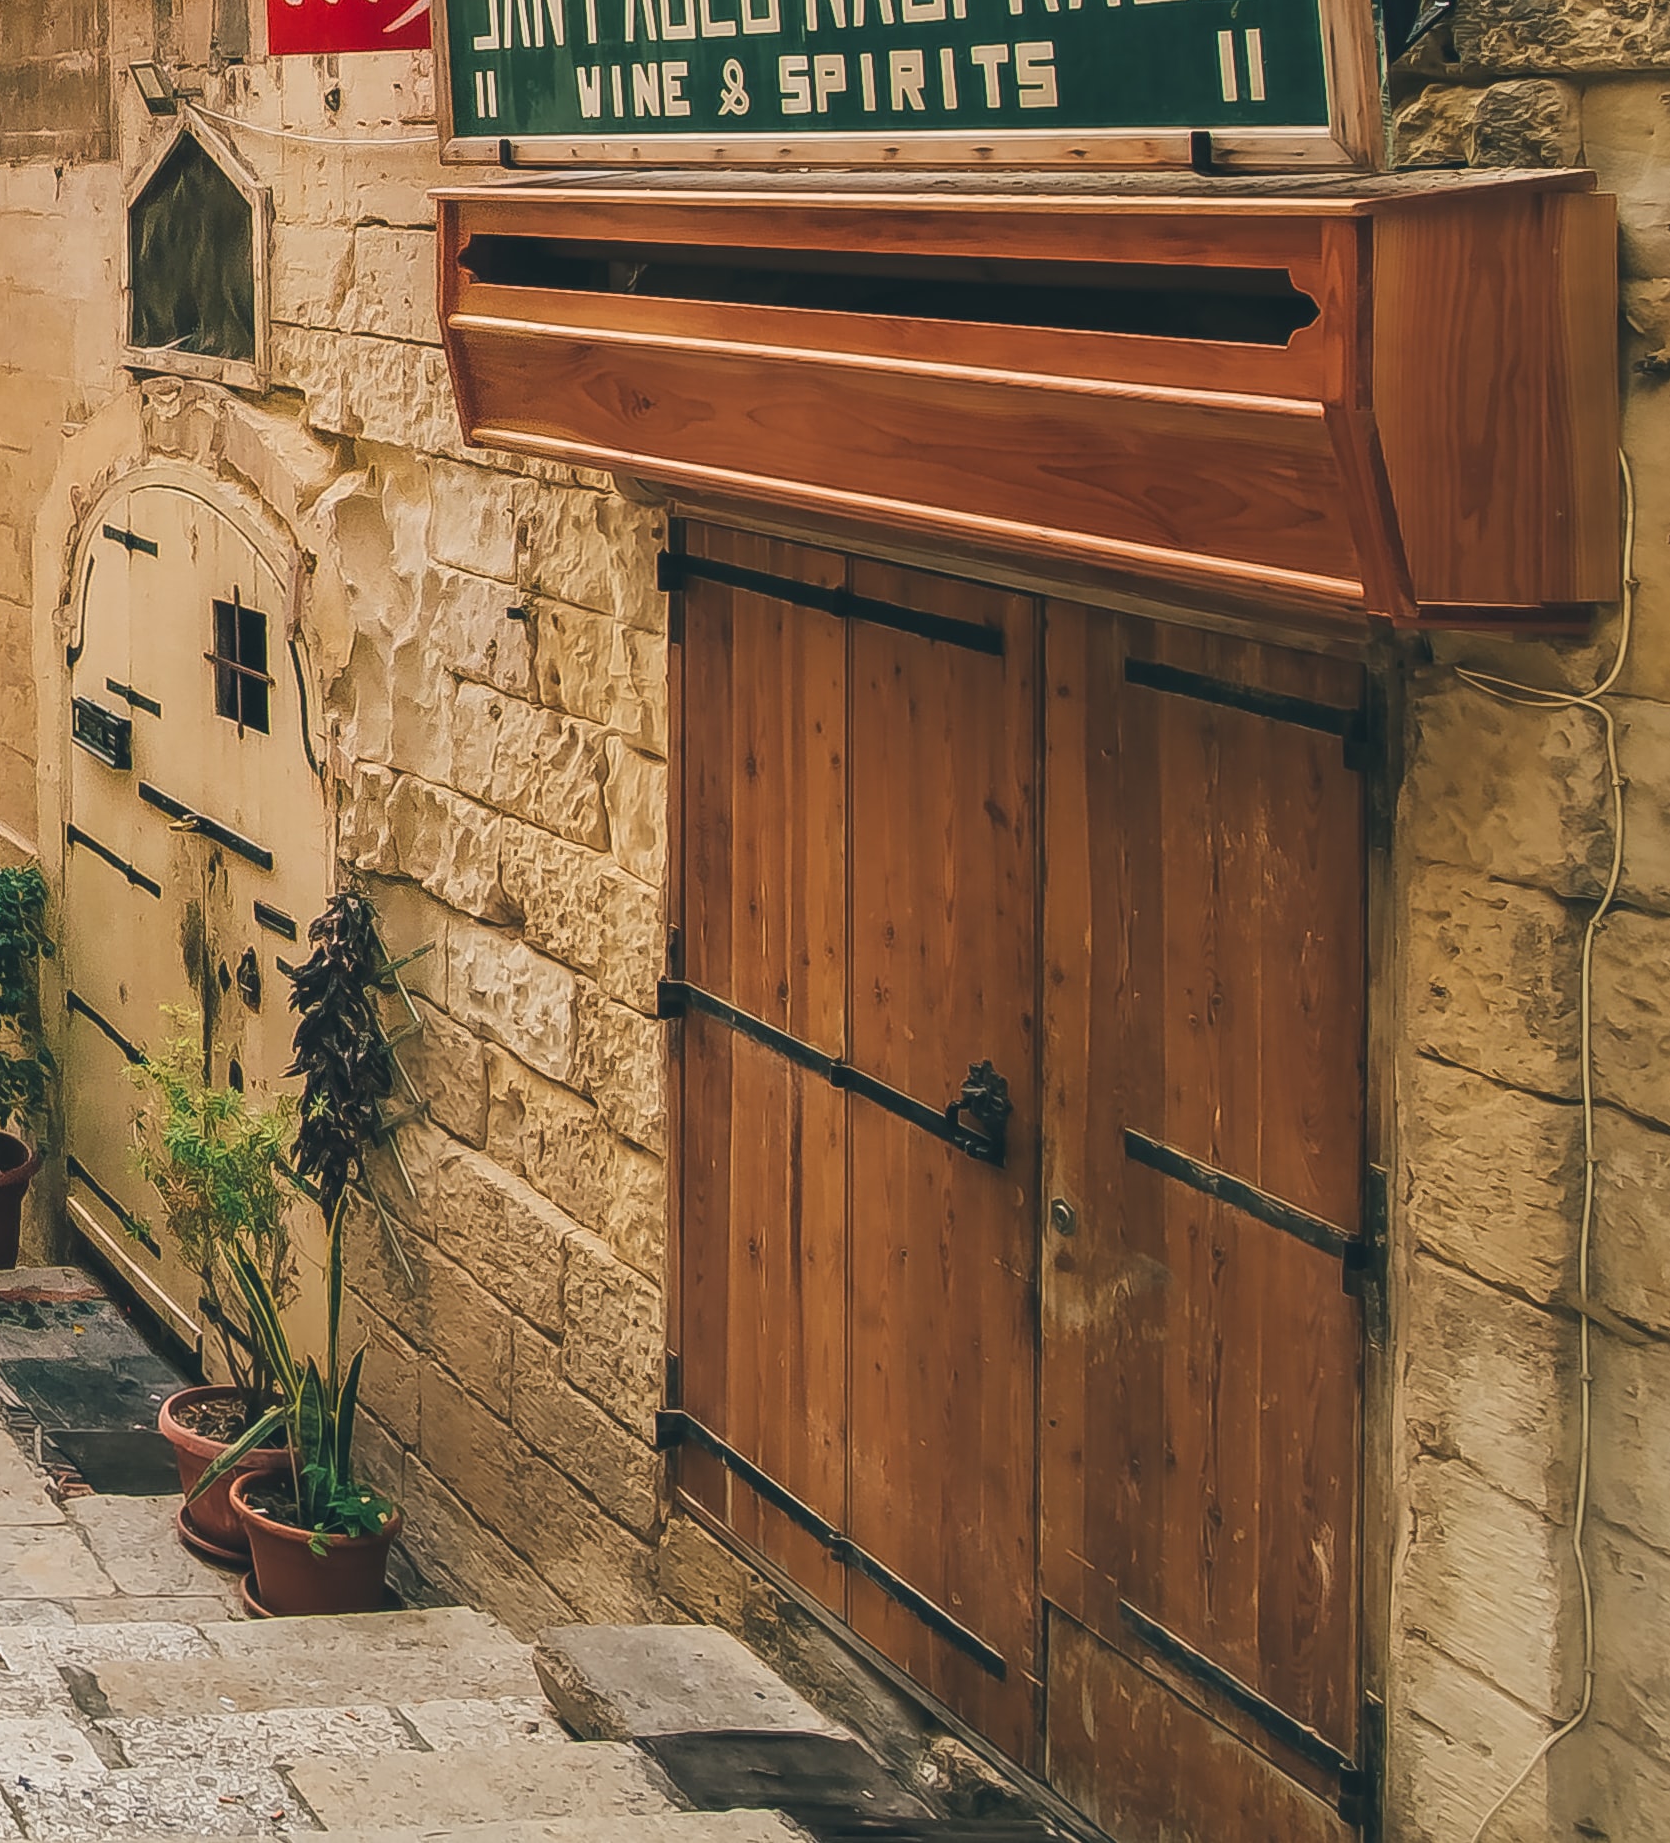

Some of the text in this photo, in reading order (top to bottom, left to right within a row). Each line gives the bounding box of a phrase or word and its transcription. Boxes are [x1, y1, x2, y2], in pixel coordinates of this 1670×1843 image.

[576, 61, 691, 119] WINE
[717, 58, 750, 116] &
[778, 40, 1059, 115] SPIRITS
